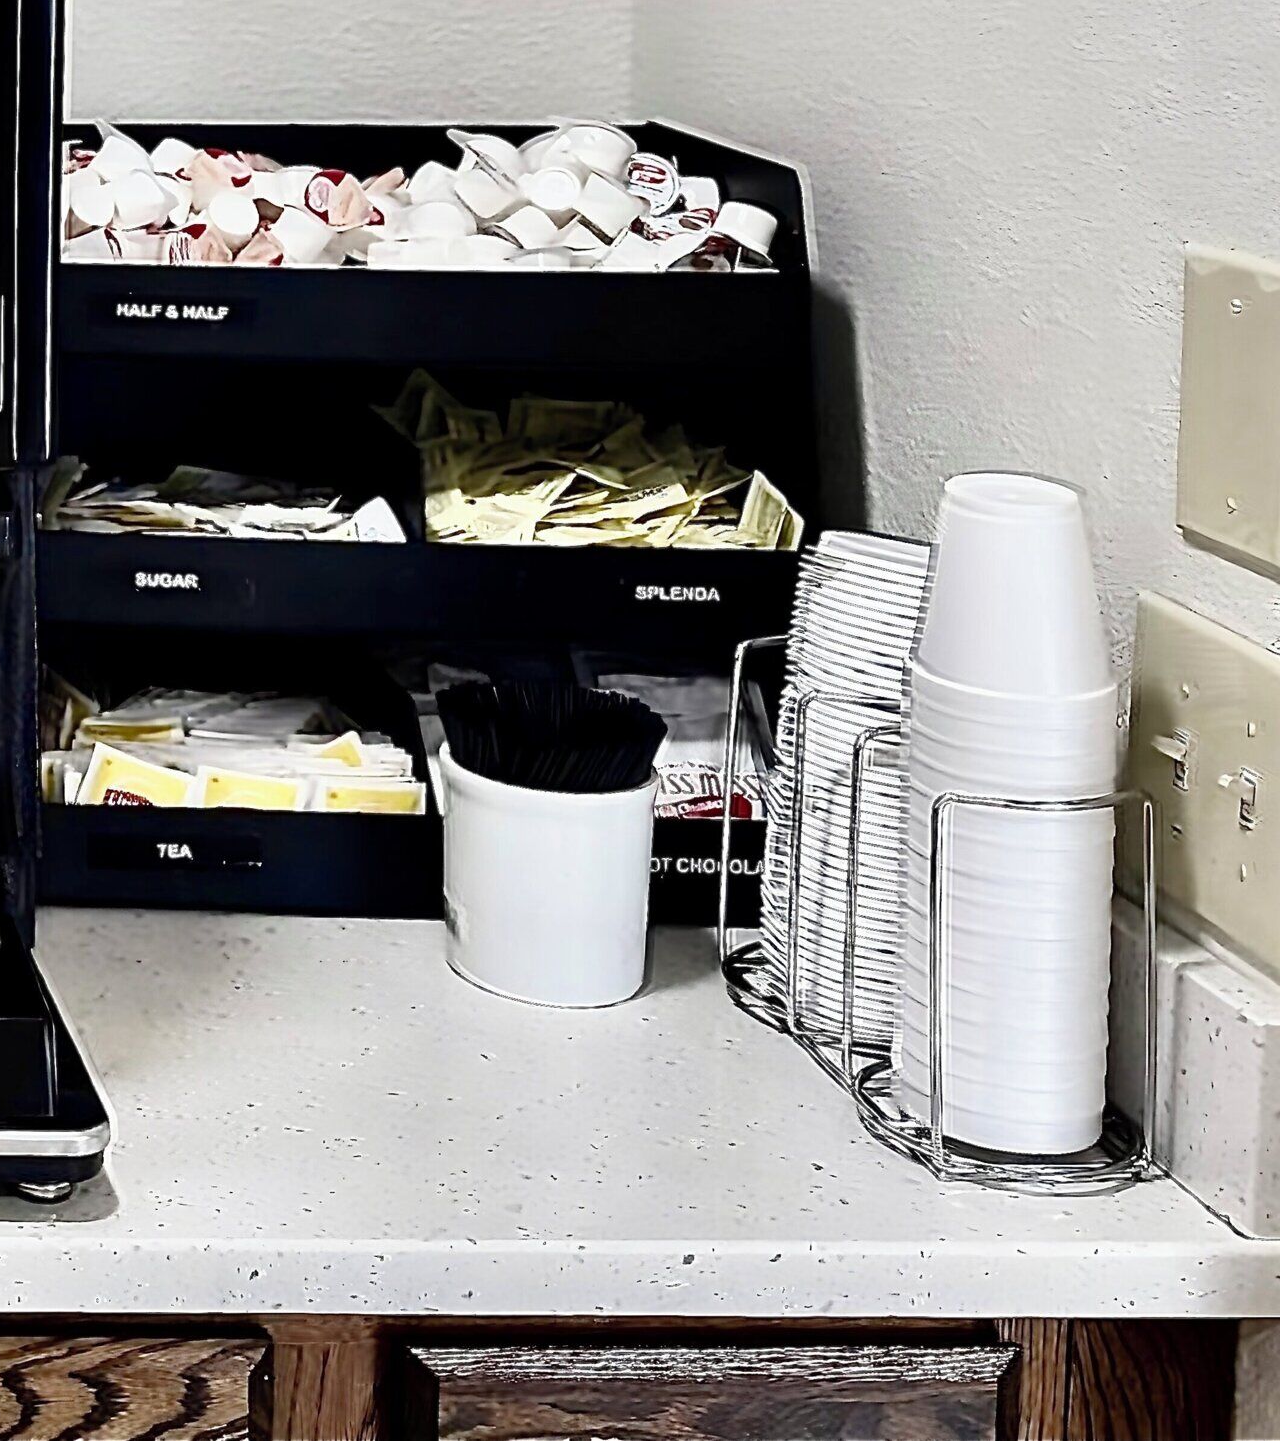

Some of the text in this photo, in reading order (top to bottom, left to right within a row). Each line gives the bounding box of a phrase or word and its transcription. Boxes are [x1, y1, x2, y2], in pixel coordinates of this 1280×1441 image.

[116, 303, 230, 321] HALF & HALF
[134, 571, 200, 589] SUGAR
[634, 584, 721, 602] SPLENDA
[156, 843, 193, 859] TEA
[649, 857, 673, 874] OT
